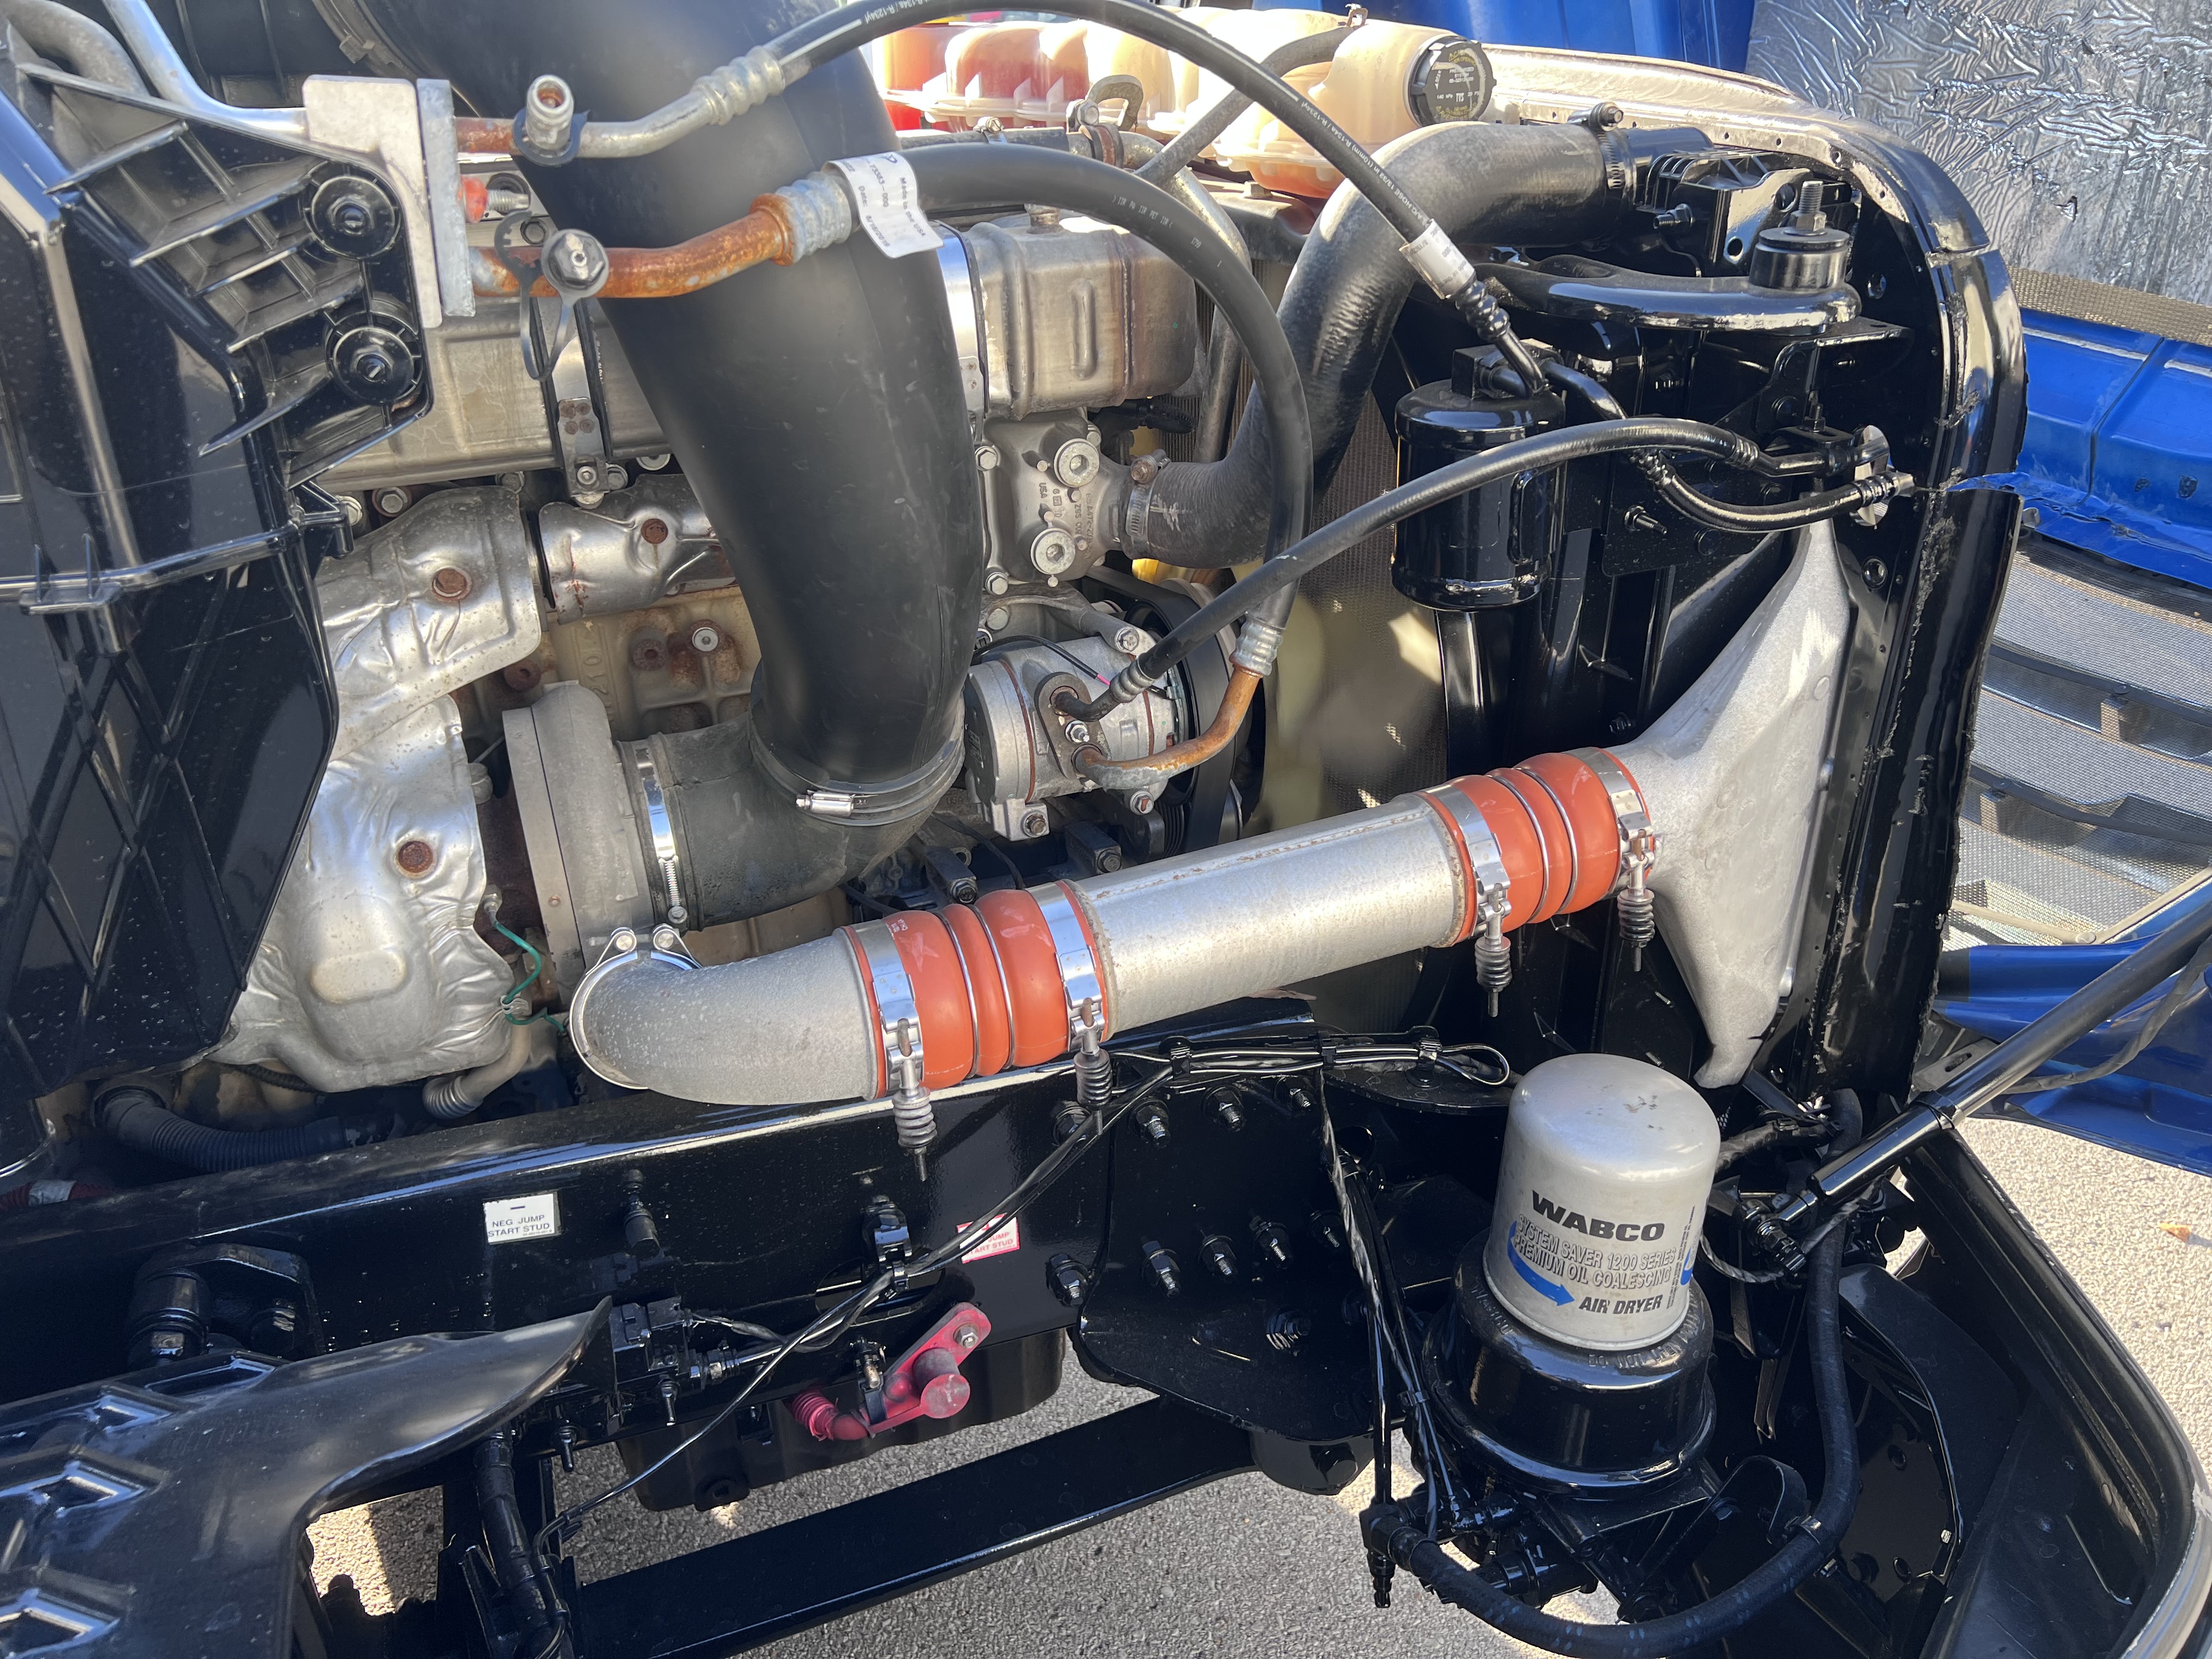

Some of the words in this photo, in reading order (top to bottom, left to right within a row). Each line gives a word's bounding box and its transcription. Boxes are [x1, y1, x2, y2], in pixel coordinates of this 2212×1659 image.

[1352, 144, 1374, 168] (10mm)
[1394, 188, 1412, 208] HOSE
[1039, 482, 1048, 498] USA
[493, 1219, 513, 1227] NEG
[518, 1215, 545, 1224] JUMP
[1532, 1190, 1665, 1242] WABCO
[488, 1227, 520, 1237] START
[523, 1223, 550, 1232] STUD
[988, 1232, 1009, 1242] JUMP
[992, 1239, 1013, 1248] STUD
[1516, 1214, 1559, 1255] SYSTEM
[1561, 1240, 1602, 1268] SAVER
[1607, 1252, 1637, 1271] 1200
[1640, 1247, 1677, 1270] SERIES
[1514, 1231, 1564, 1278] PREMIUM
[1567, 1263, 1589, 1285] OIL
[1593, 1266, 1672, 1290] COALESCING
[1579, 1296, 1610, 1314] AIR
[1612, 1294, 1663, 1314] DRYER
